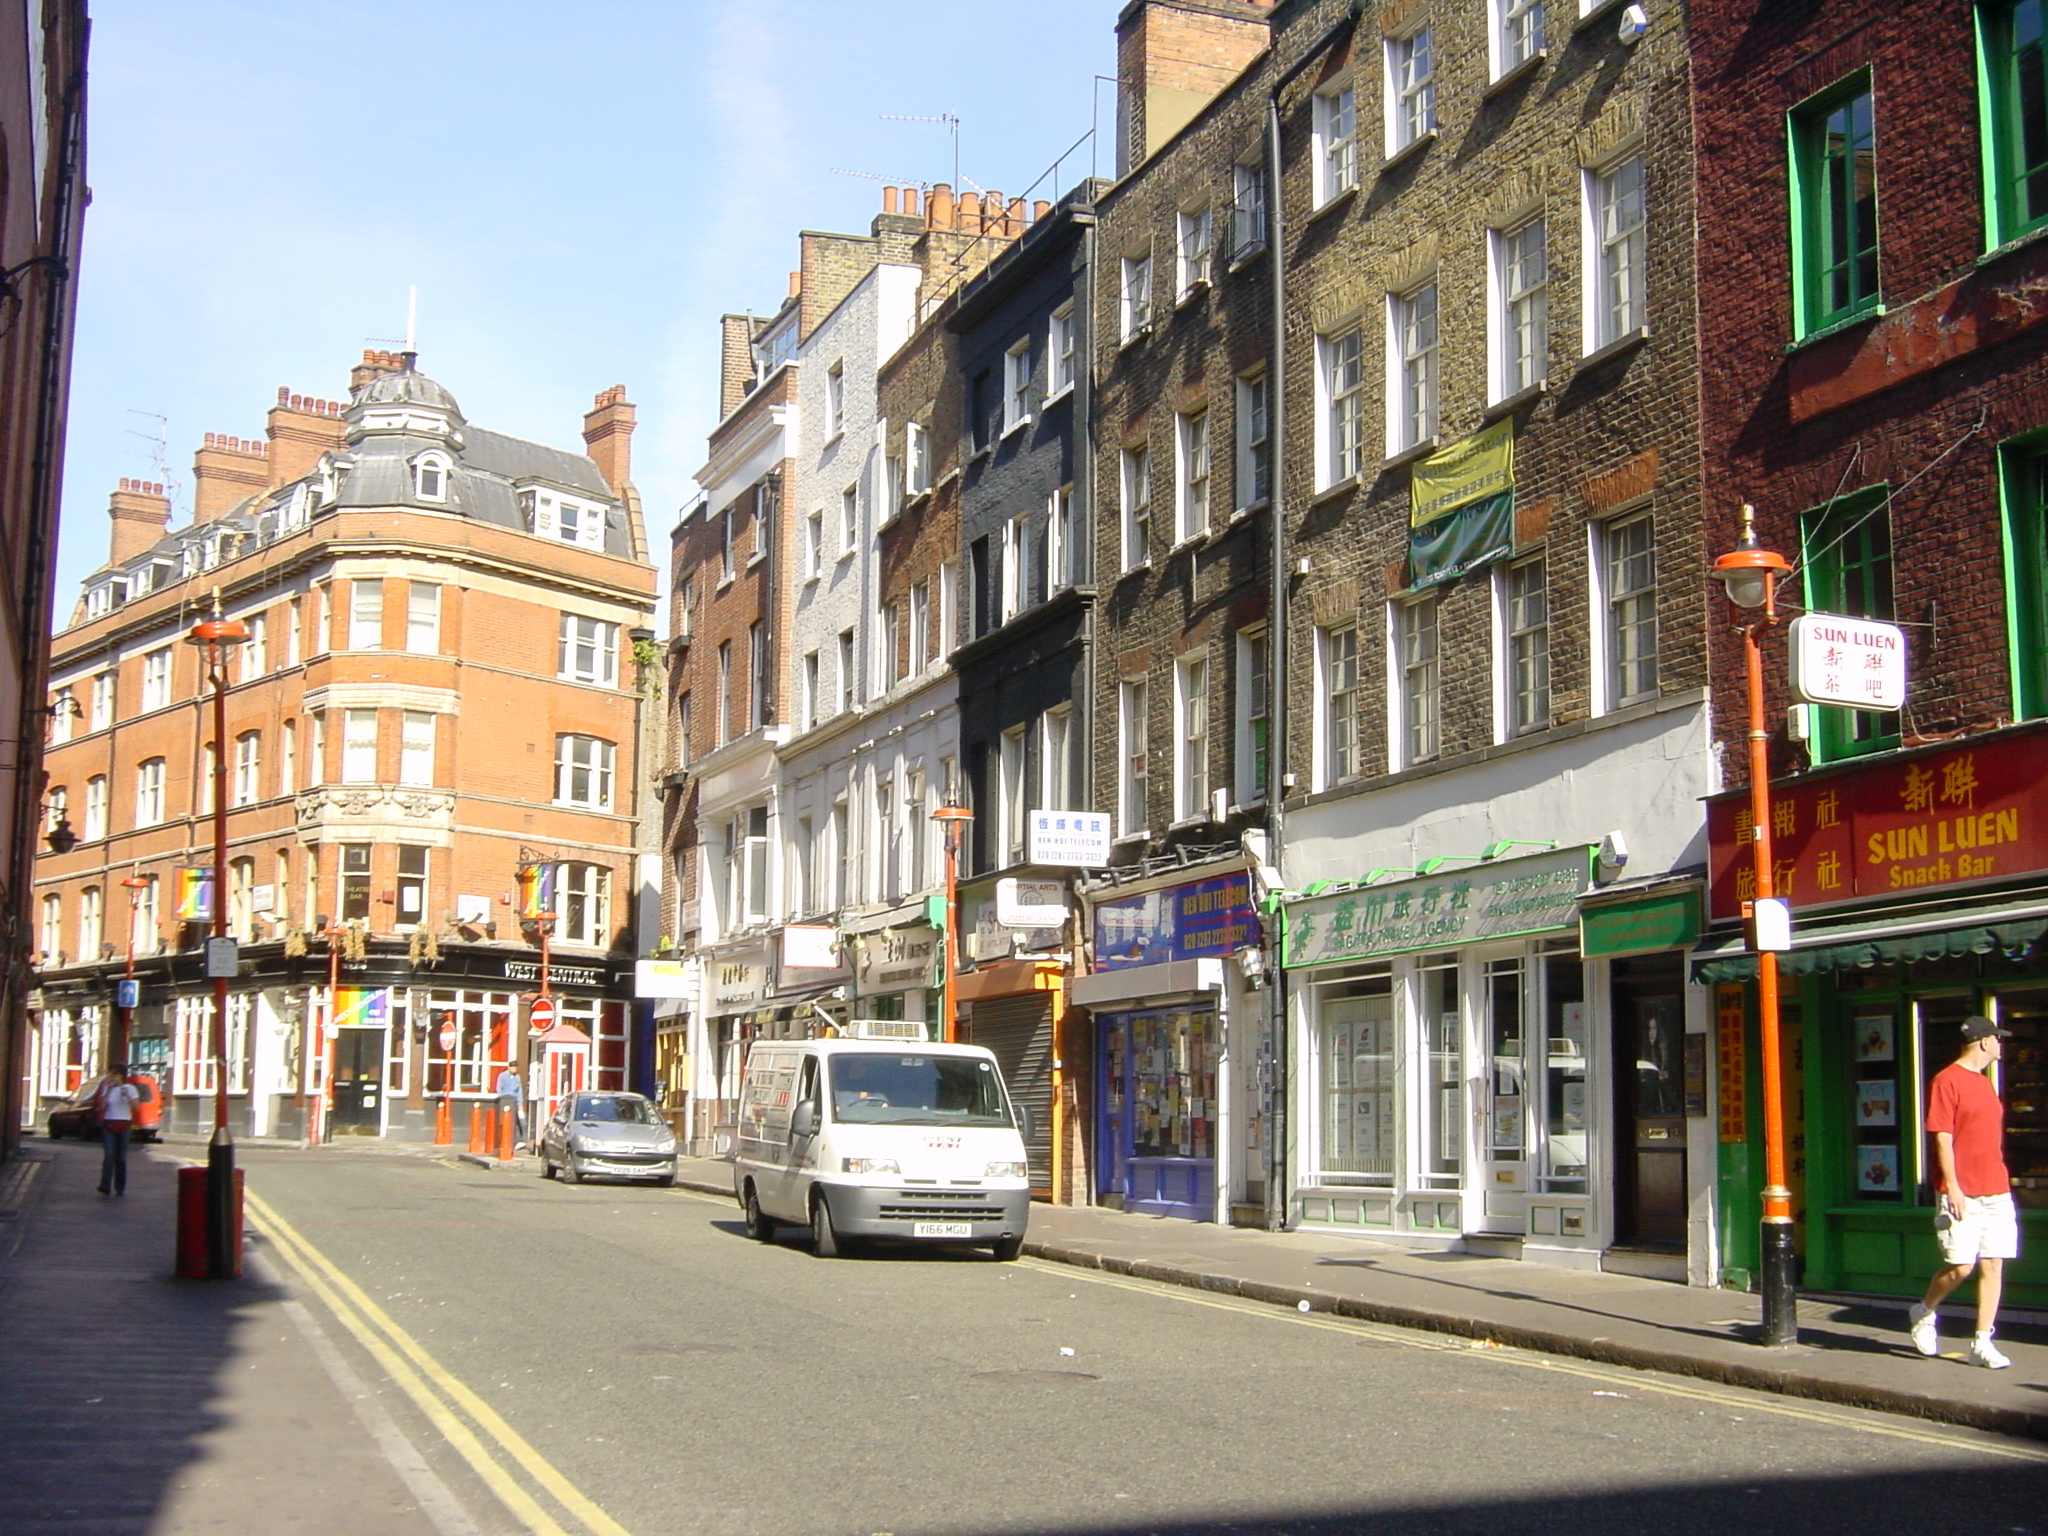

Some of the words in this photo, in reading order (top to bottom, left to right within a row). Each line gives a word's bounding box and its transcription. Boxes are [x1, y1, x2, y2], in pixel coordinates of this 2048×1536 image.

[1814, 626, 1847, 643] SUN
[1854, 632, 1895, 650] LUEN
[1899, 753, 1979, 816] 新聯
[1868, 824, 1928, 864] SUN
[1938, 808, 2019, 853] LUEN
[1889, 857, 1951, 888] Snack
[1958, 854, 1995, 878] Bar
[1420, 916, 1468, 937] AGENCY
[505, 962, 536, 980] WEST
[919, 1223, 944, 1235] Y166
[946, 1223, 968, 1235] MGU
